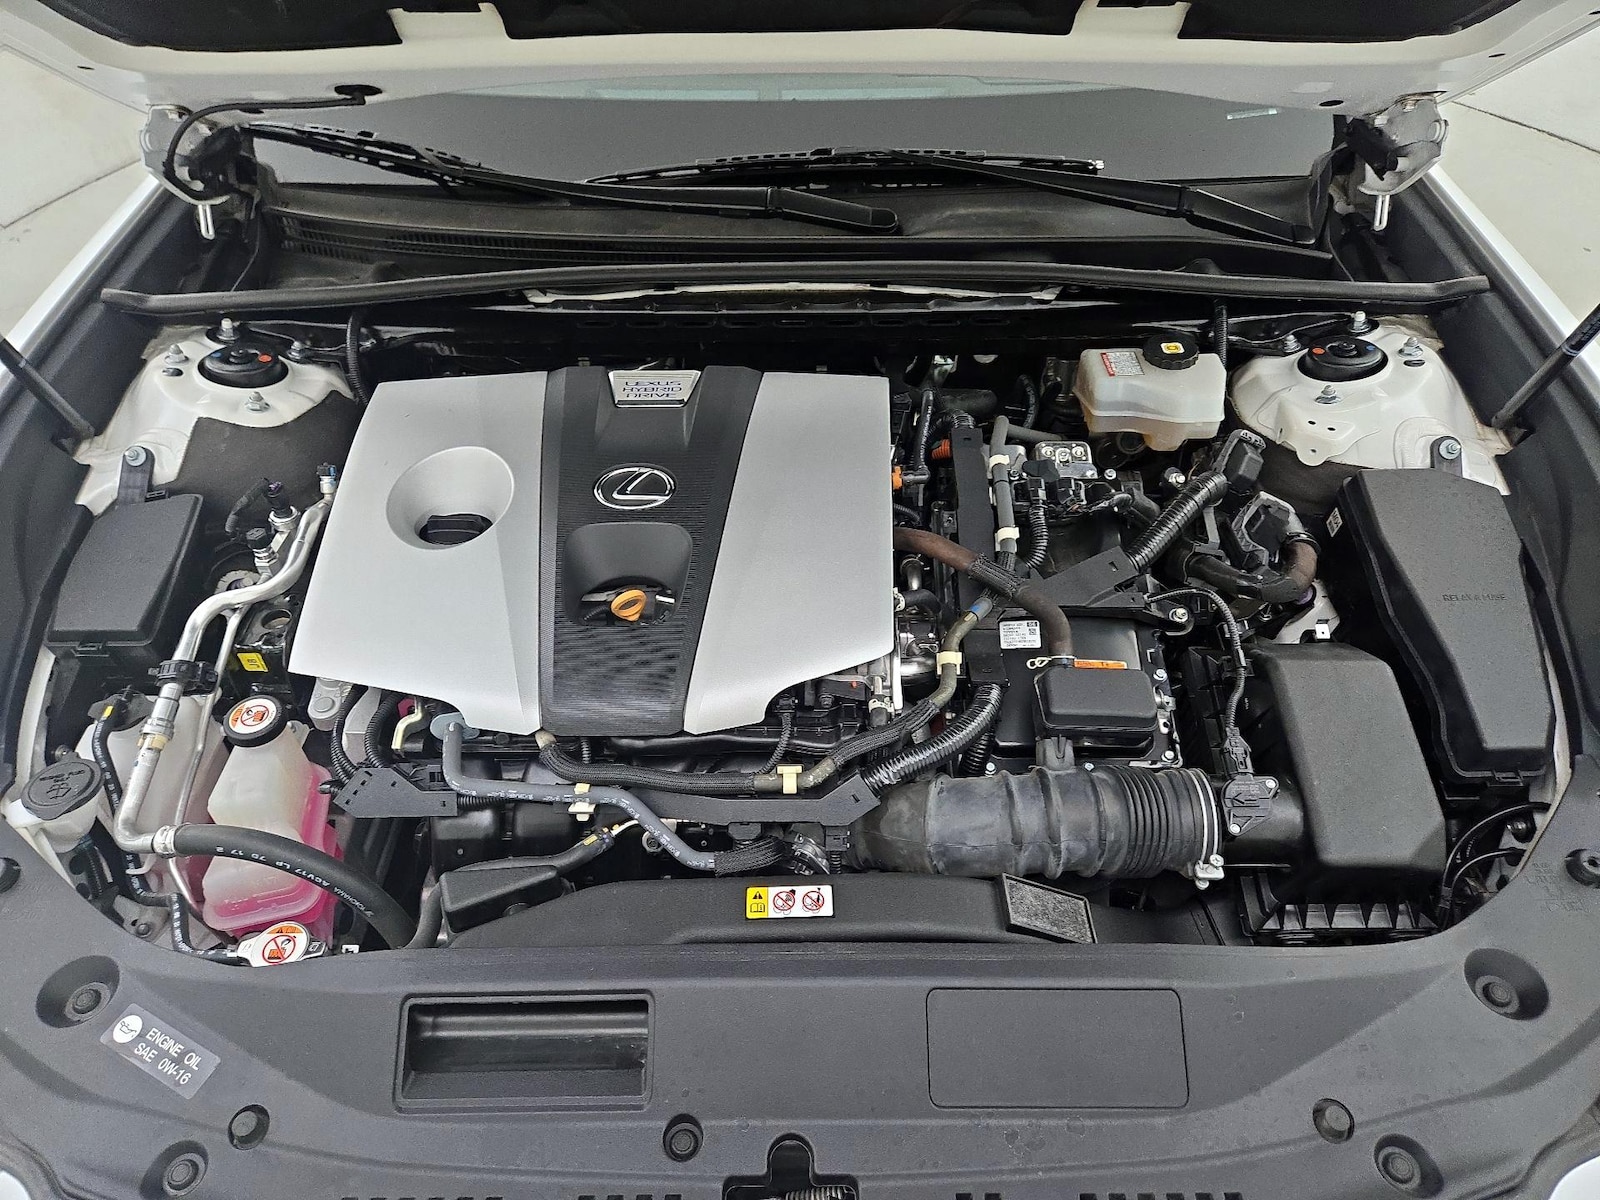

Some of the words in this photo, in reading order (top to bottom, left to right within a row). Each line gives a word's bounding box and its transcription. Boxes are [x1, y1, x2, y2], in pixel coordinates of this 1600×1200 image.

[275, 861, 291, 869] LP
[134, 1042, 158, 1063] SAE
[157, 1058, 192, 1085] 0W-16
[145, 1027, 185, 1057] ENGINE
[184, 1052, 202, 1071] OIL
